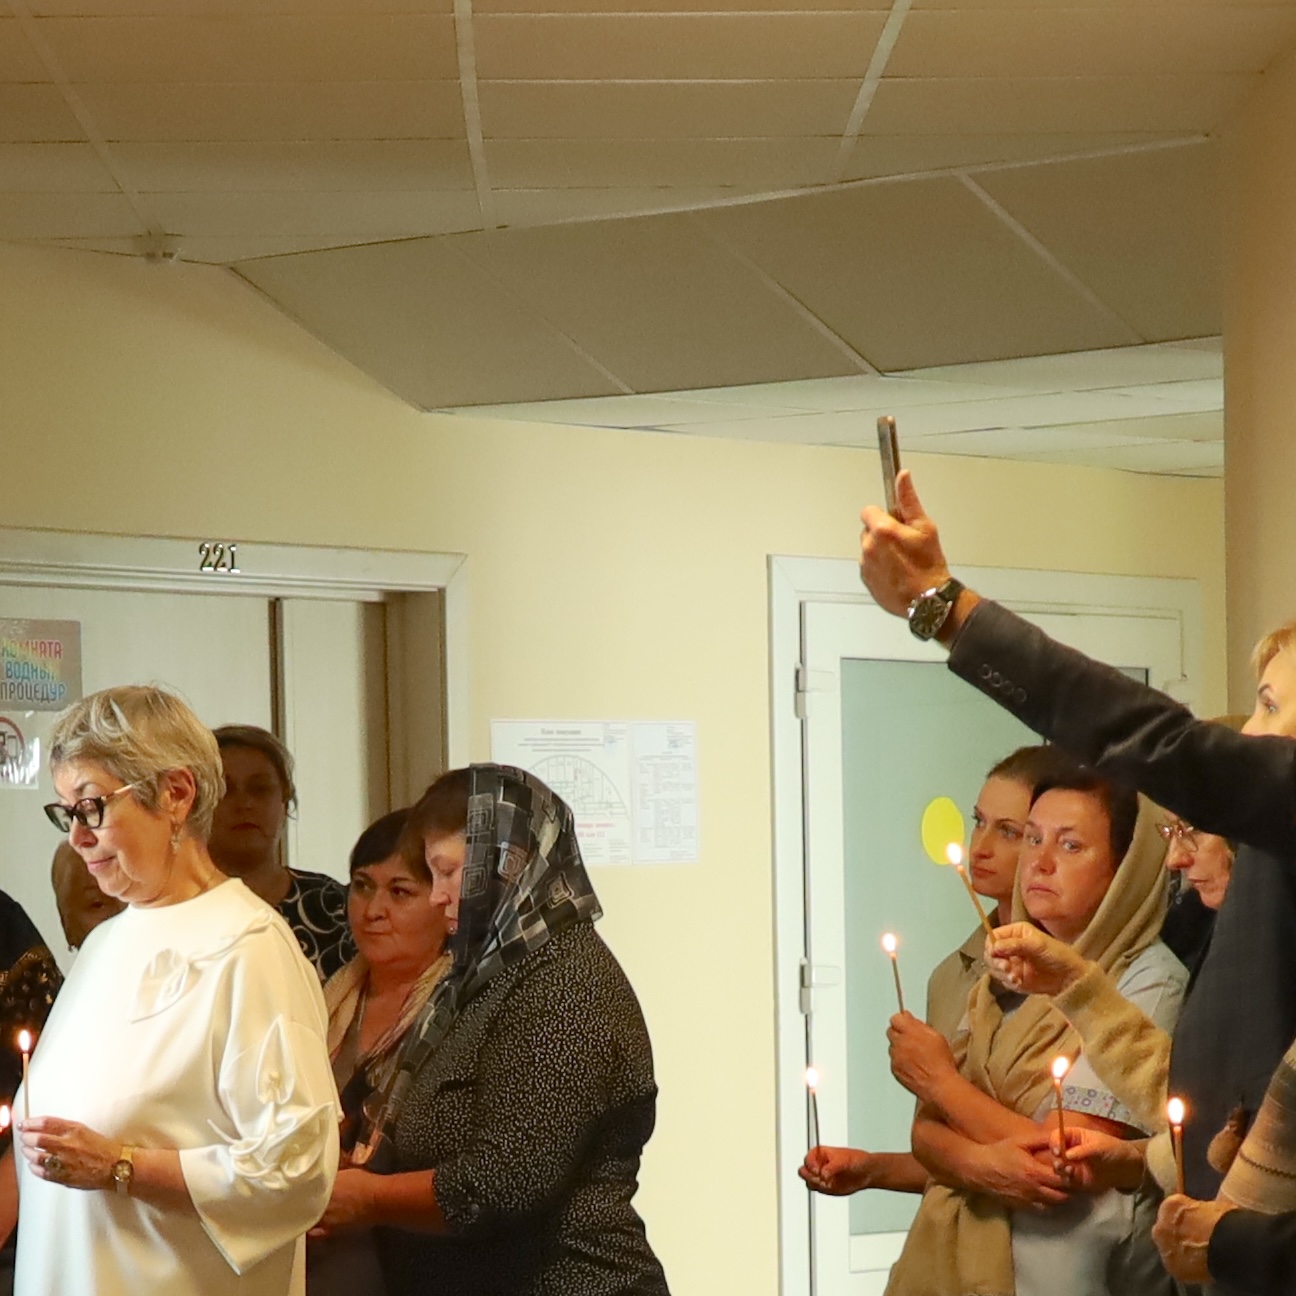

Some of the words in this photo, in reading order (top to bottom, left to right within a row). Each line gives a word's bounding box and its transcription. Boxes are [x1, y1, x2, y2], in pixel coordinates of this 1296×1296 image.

[198, 542, 241, 573] 221
[5, 660, 59, 682] ВОДНЫ
[0, 681, 66, 704] ПРОЦЕДУР
